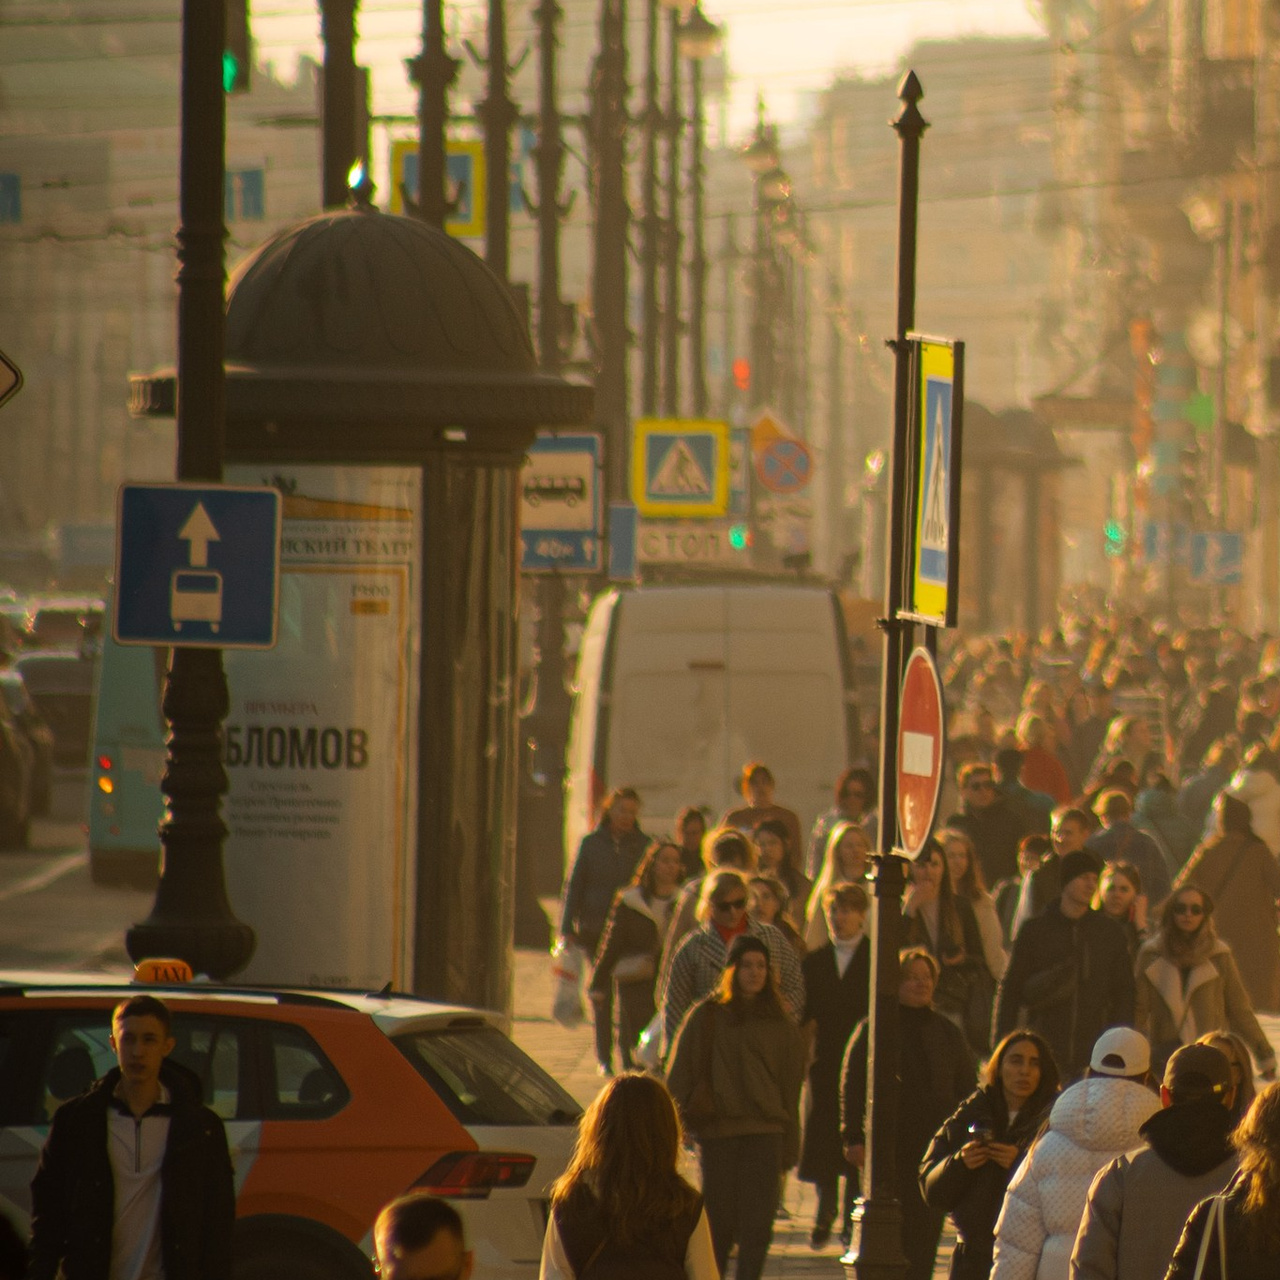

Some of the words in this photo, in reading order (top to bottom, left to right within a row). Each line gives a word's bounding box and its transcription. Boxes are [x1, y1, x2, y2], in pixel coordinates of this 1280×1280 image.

[642, 532, 721, 558] СТОП
[225, 724, 369, 770] БЛОМОВ
[152, 965, 187, 982] TAXI
